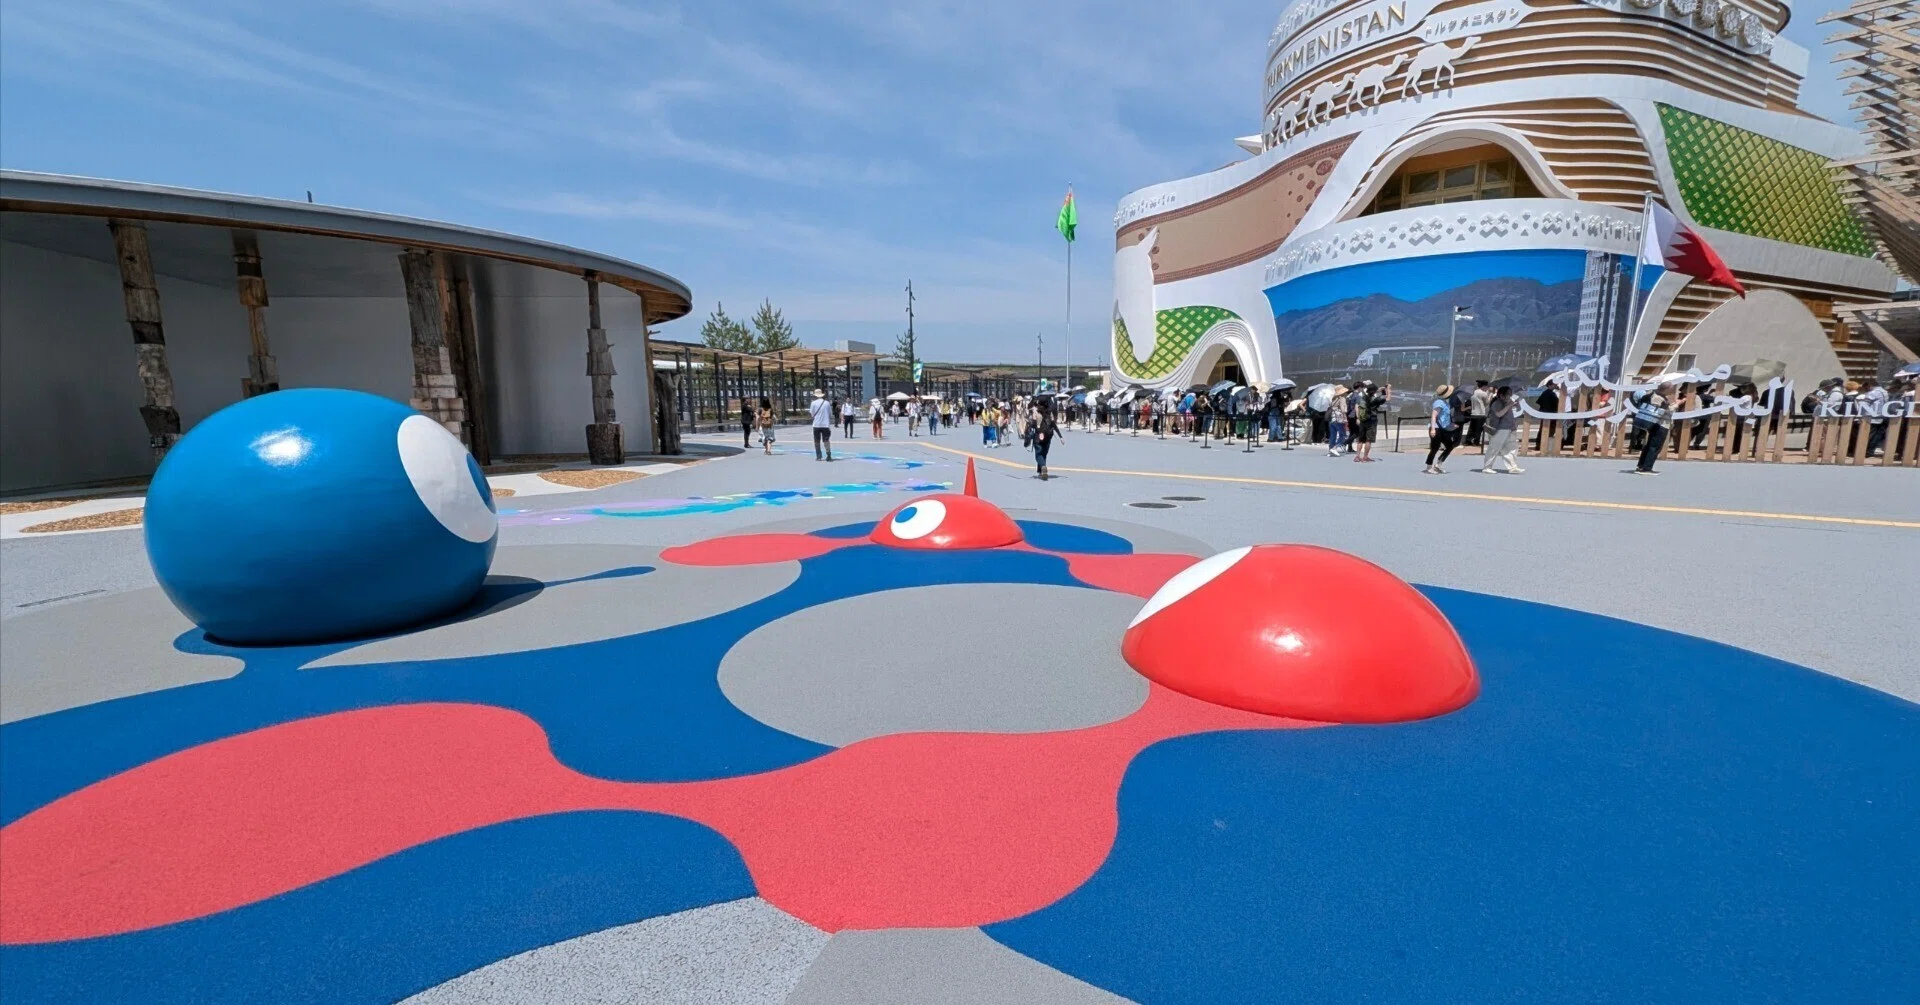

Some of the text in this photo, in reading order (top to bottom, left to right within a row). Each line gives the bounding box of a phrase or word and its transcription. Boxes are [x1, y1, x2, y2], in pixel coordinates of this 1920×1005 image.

[1267, 1, 1406, 90] TURKMENISTAN
[1425, 7, 1519, 38] トルクメニスタン
